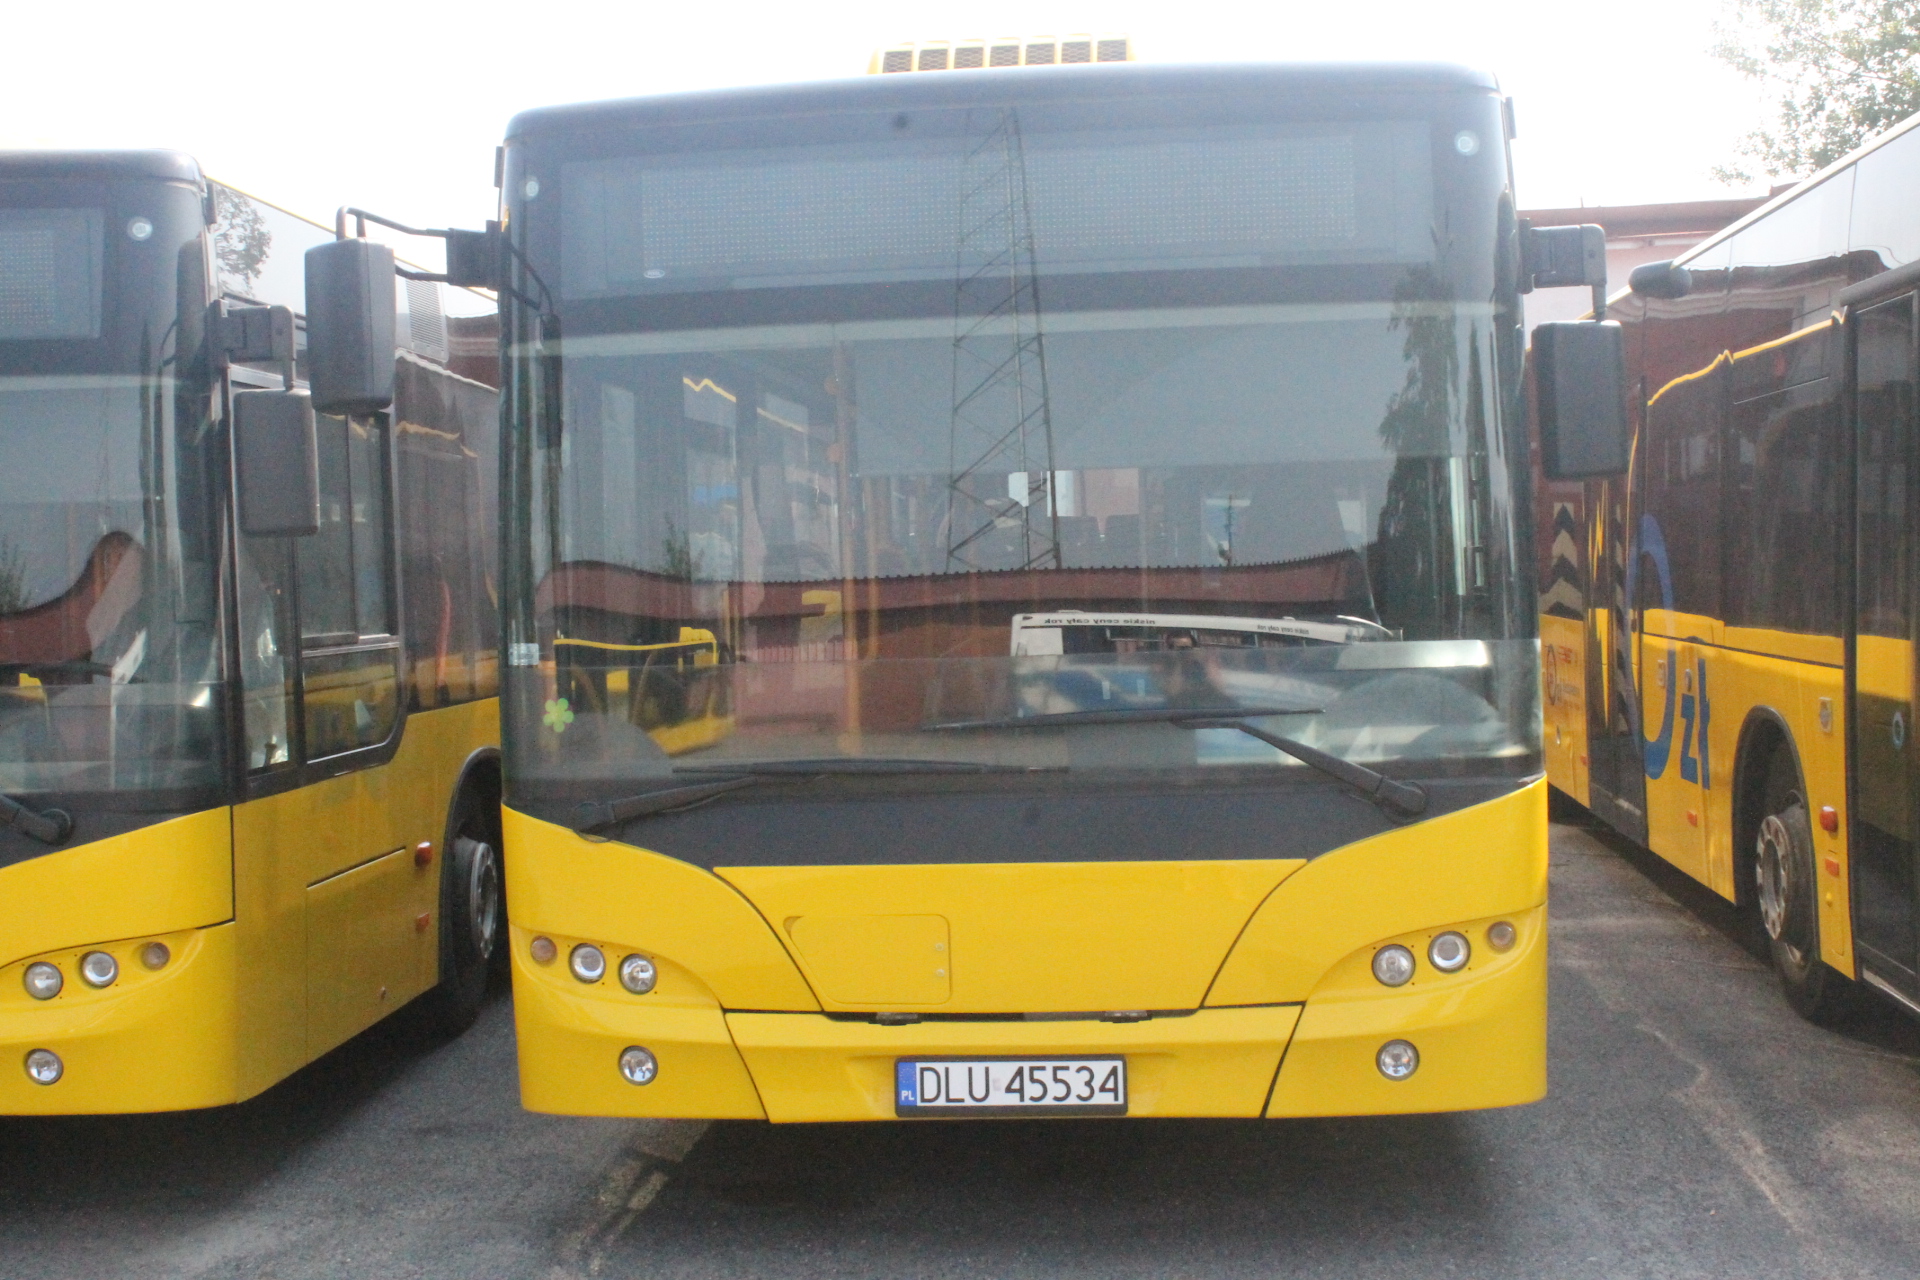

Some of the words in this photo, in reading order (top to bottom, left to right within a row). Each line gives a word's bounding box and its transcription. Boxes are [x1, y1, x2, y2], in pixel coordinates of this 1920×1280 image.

[901, 1090, 915, 1101] PL
[920, 1066, 990, 1103] DLU
[1005, 1065, 1119, 1103] 45534
